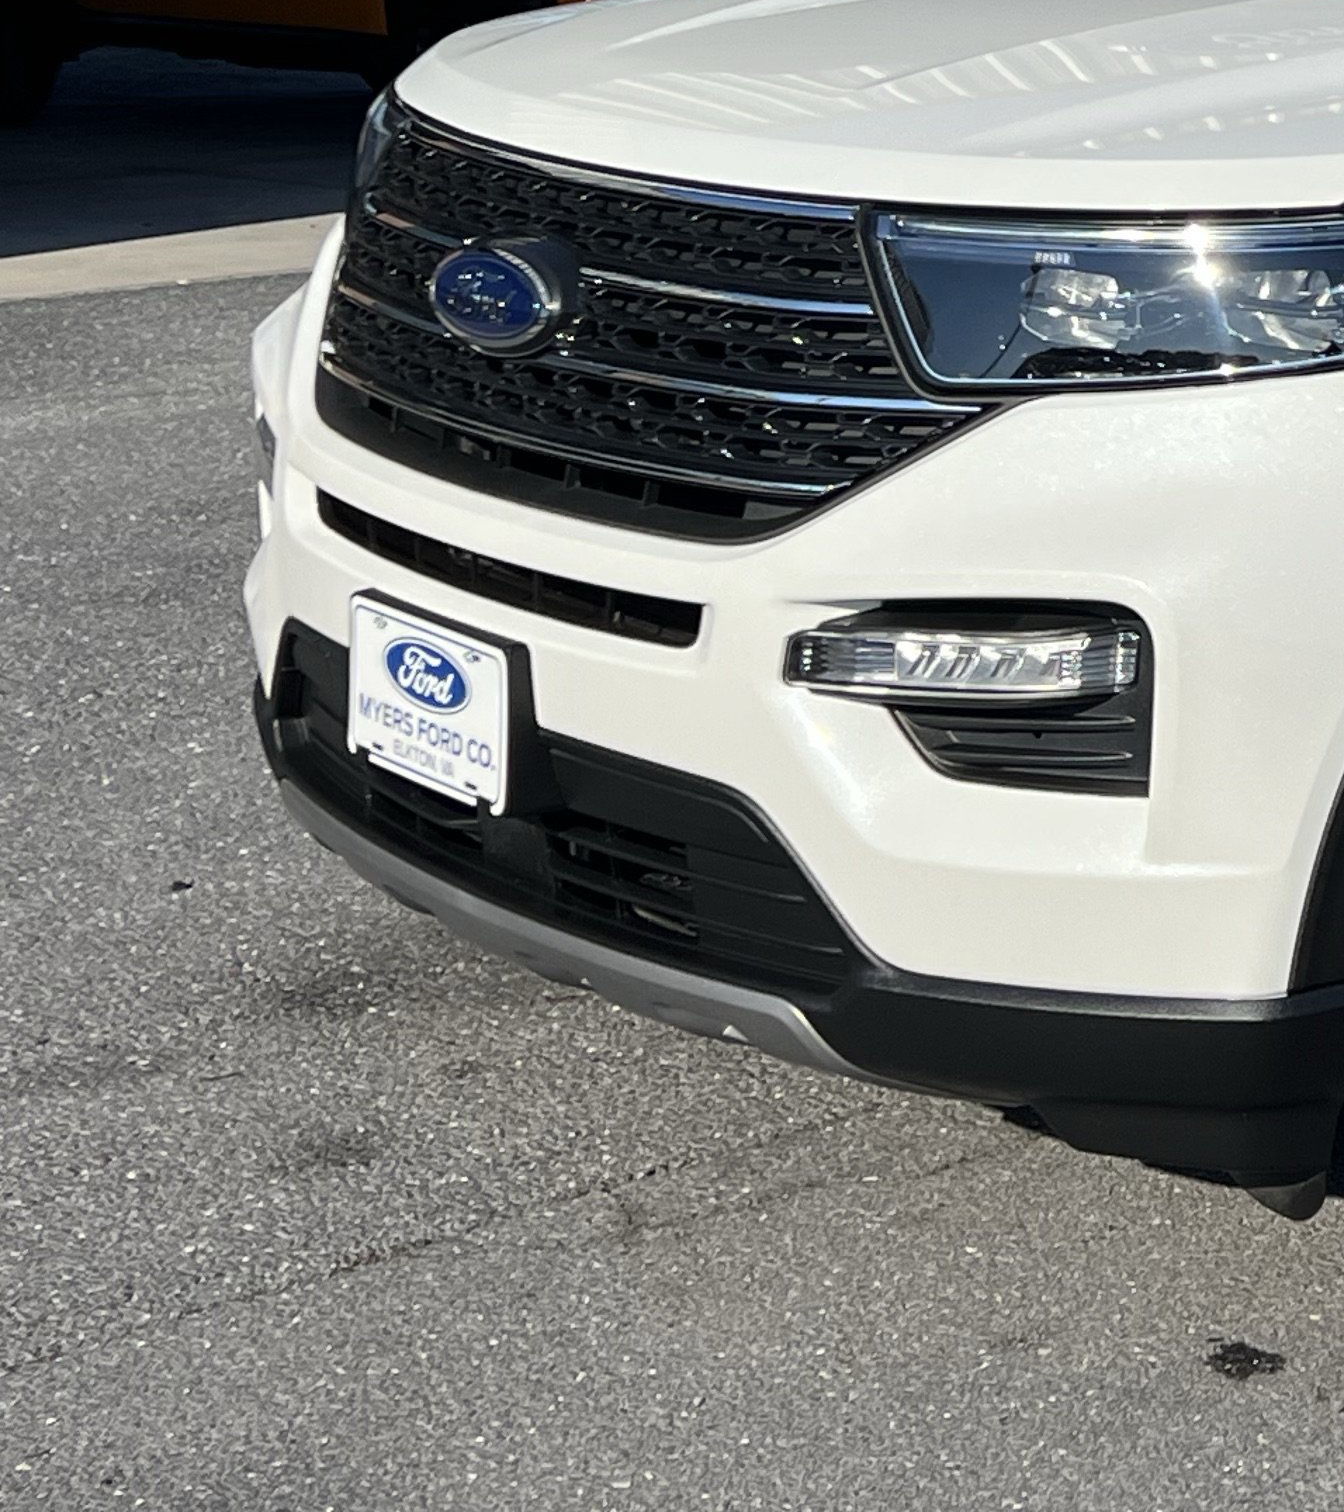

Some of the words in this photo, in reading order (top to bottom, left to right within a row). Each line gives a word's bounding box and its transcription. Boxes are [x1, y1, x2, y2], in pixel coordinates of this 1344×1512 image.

[397, 646, 455, 704] Ford
[359, 693, 414, 737] MYERS
[417, 717, 463, 756] FORD
